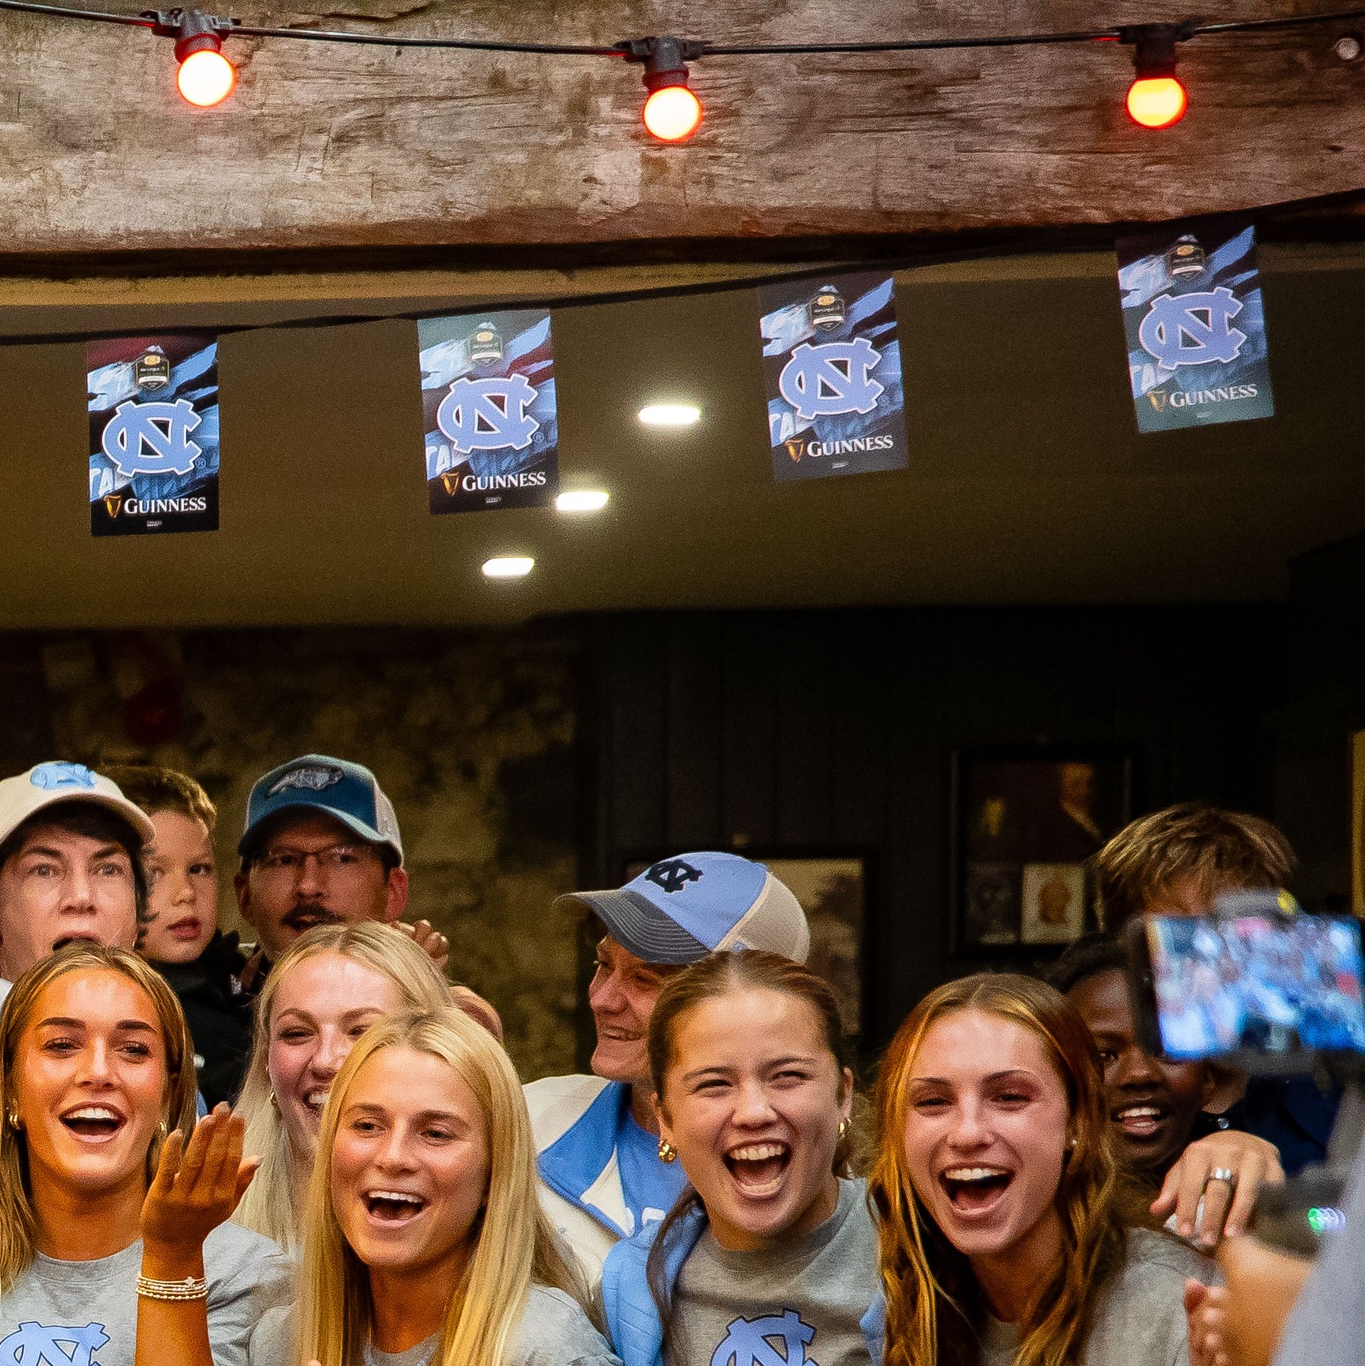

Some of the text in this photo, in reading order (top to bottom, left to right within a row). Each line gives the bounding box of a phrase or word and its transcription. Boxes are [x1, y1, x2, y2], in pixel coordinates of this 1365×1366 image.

[1168, 383, 1259, 409] GUINNESS
[806, 434, 894, 458] GUINNESS
[461, 471, 547, 493] GUINNESS
[122, 495, 207, 517] GUINNESS
